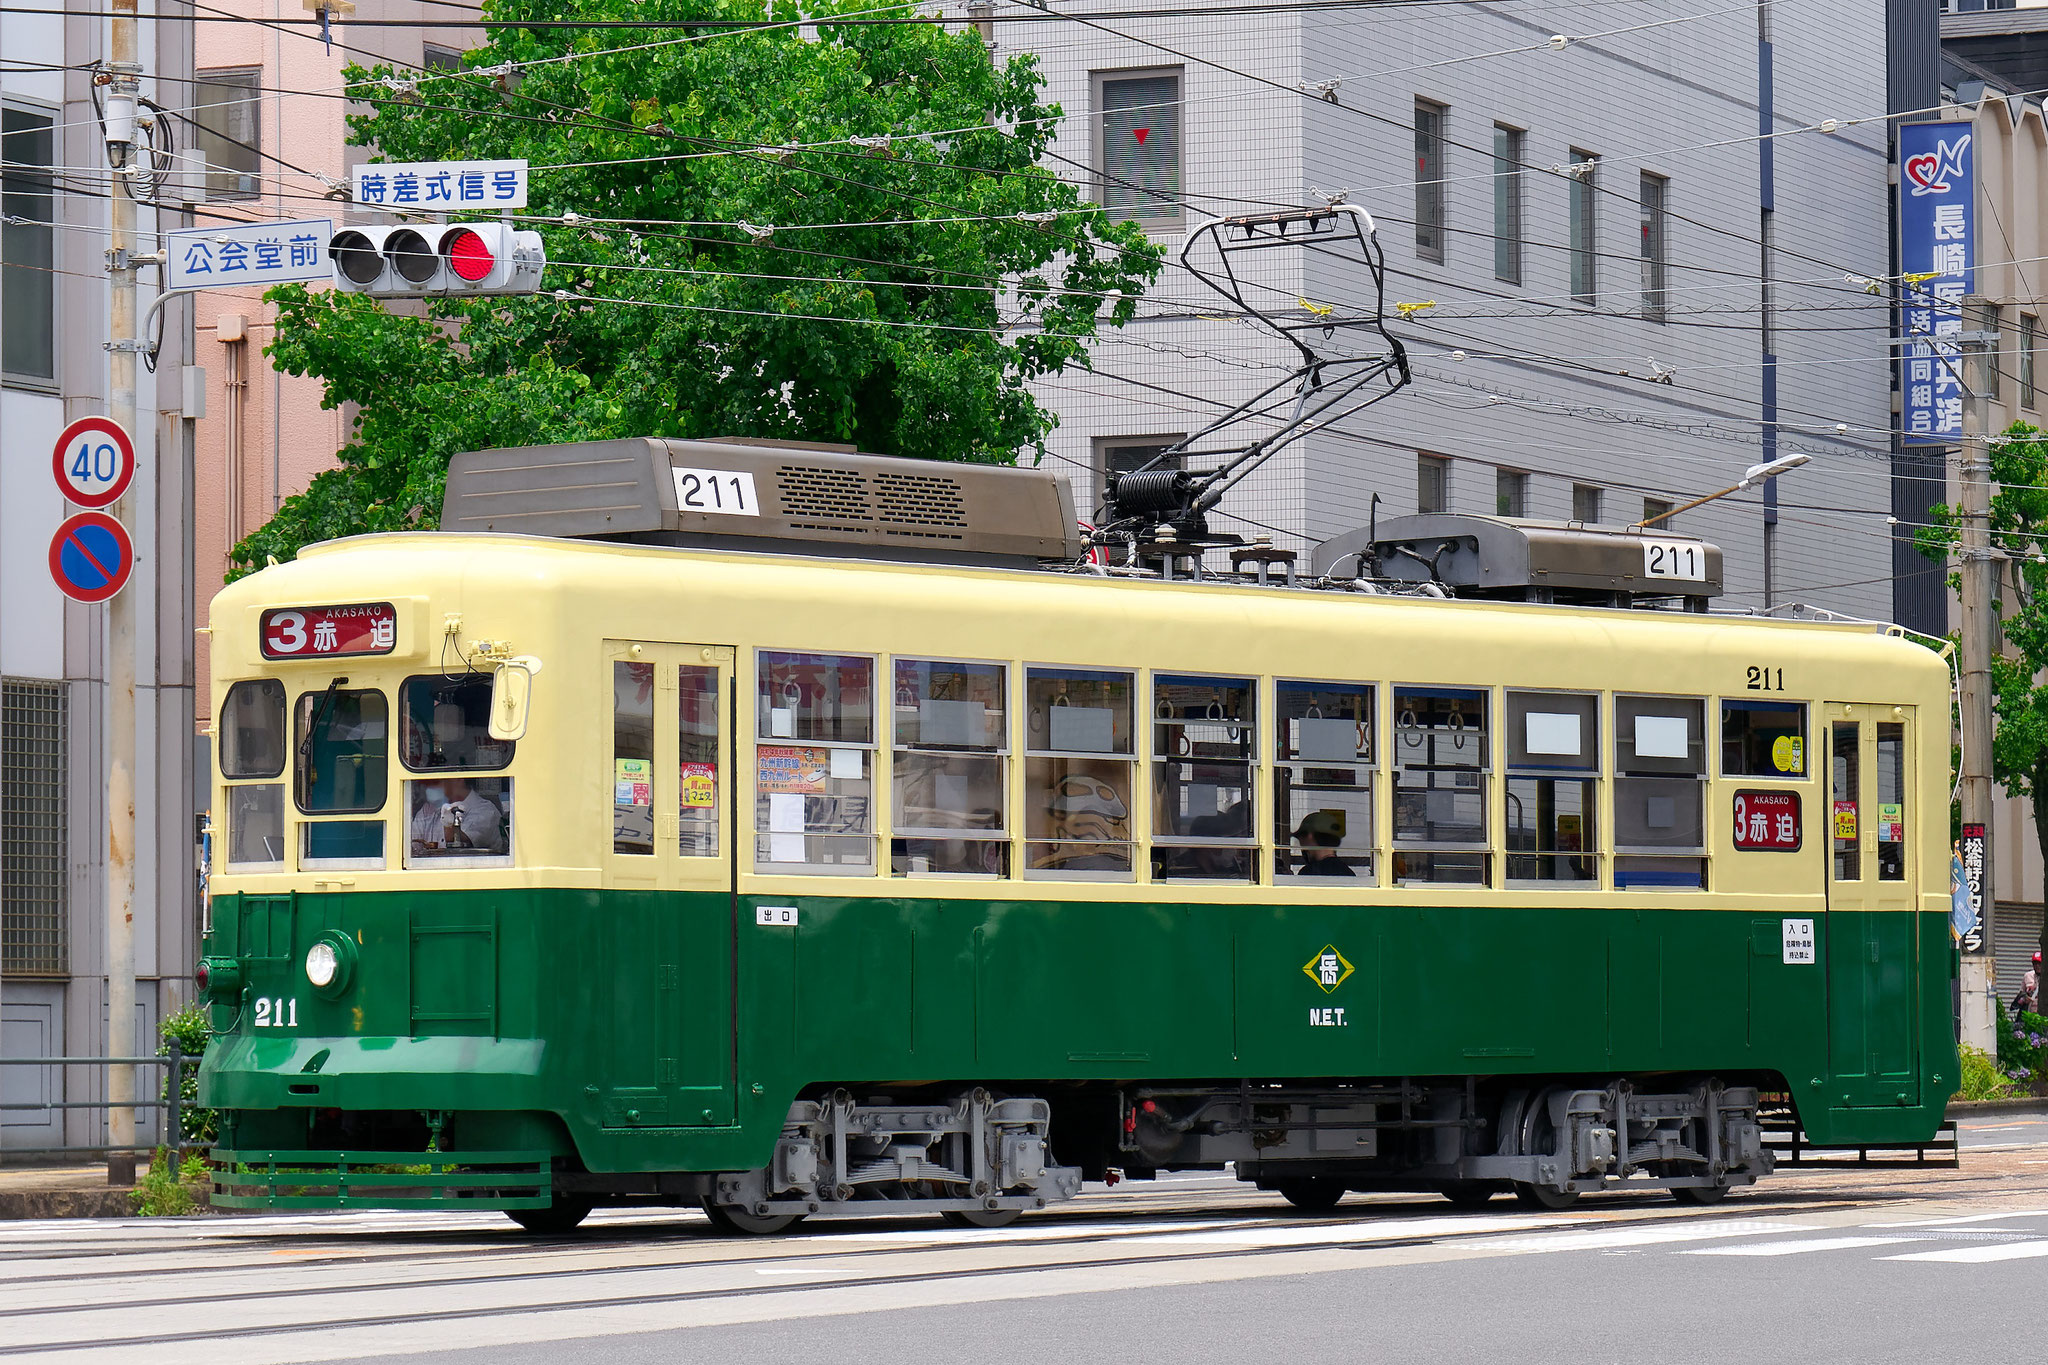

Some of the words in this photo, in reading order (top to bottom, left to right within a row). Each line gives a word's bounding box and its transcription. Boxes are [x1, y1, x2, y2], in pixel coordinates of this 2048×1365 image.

[361, 170, 519, 204] 時差式信号
[184, 234, 319, 275] 公会堂前
[71, 443, 116, 483] 40
[682, 474, 745, 510] 211
[1651, 545, 1695, 577] 211
[326, 606, 381, 618] AKASAKO
[268, 611, 307, 653] 3
[313, 616, 394, 652] 赤迫
[1746, 666, 1784, 691] 211
[760, 757, 800, 769] 九州新幹線
[760, 769, 804, 781] 西九州ルート
[1754, 796, 1789, 805] AKASAKO
[1735, 796, 1746, 842] 3
[1750, 812, 1794, 842] 赤迫
[763, 908, 790, 923] 出口
[1788, 924, 1808, 934] 入口
[254, 997, 298, 1028] 211
[1309, 1008, 1348, 1026] N.E.T.
